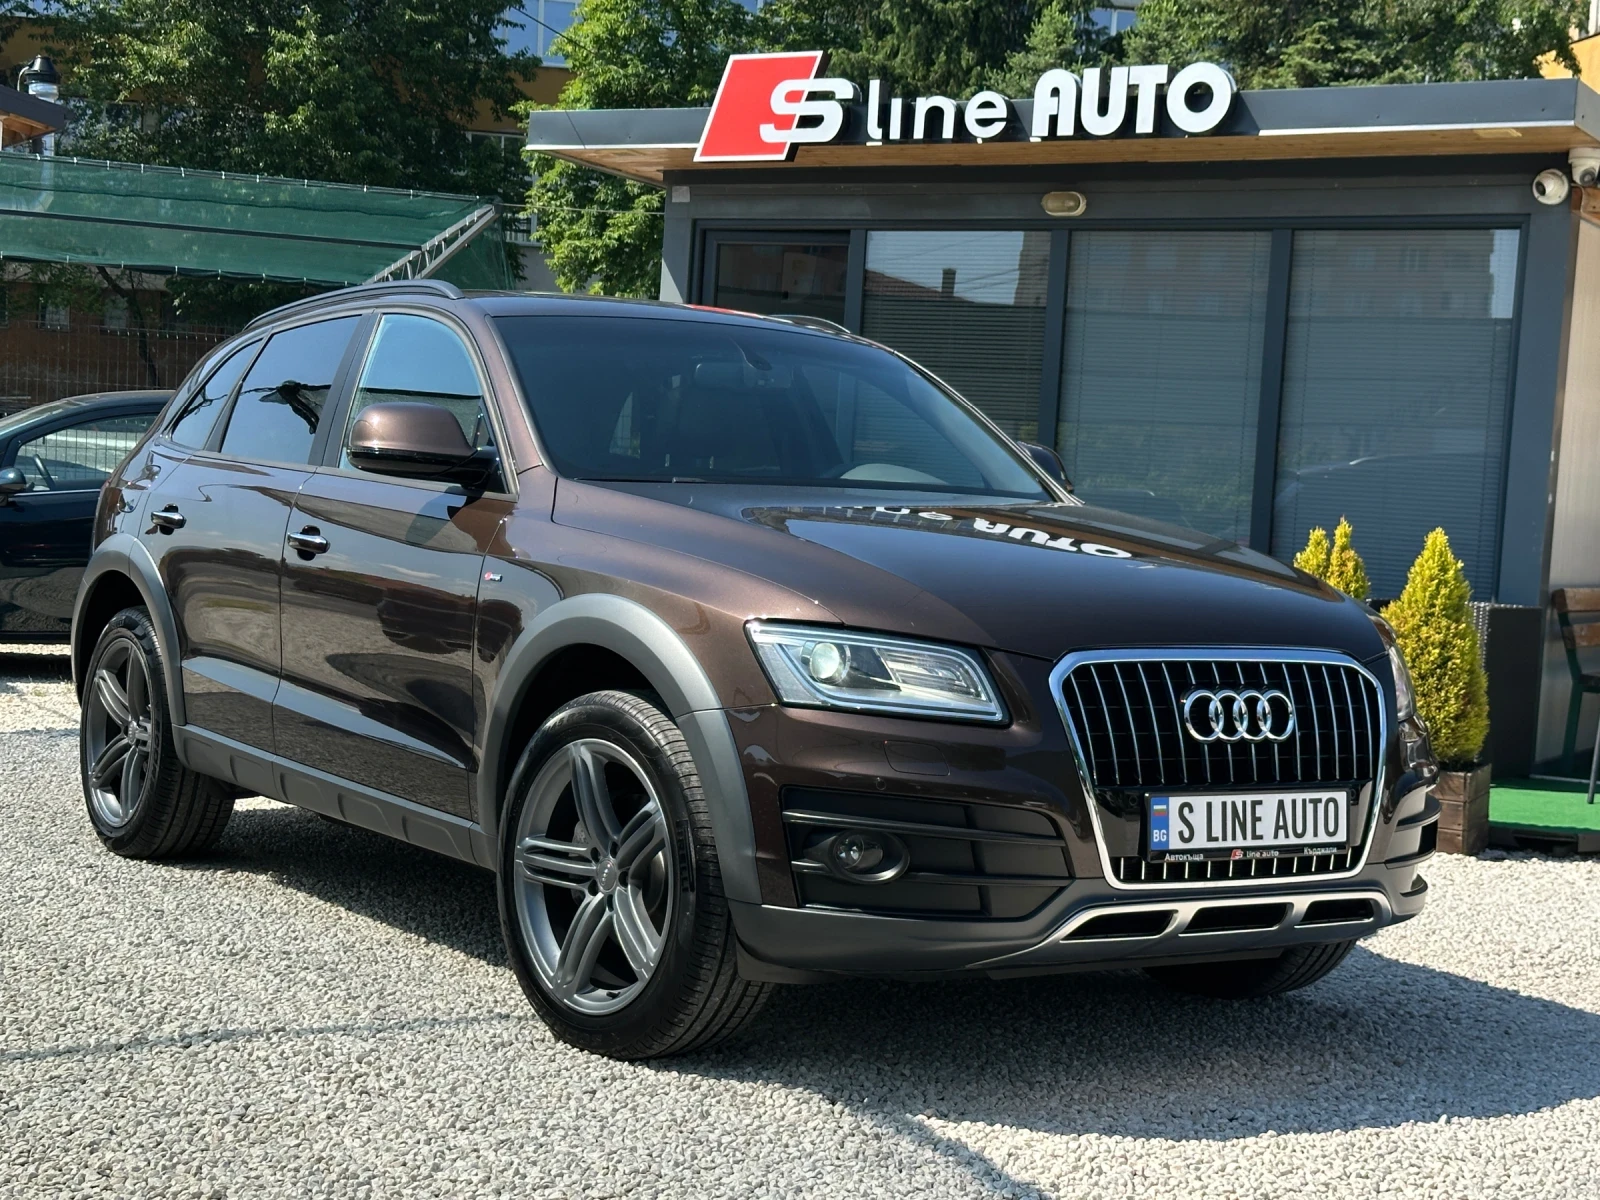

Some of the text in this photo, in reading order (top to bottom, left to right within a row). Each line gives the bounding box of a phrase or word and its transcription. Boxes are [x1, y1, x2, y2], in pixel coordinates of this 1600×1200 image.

[759, 62, 1235, 143] S line AUTO
[1153, 829, 1167, 842] BG
[1177, 797, 1340, 844] S LINE AUTO
[1164, 852, 1204, 861] Автокъща
